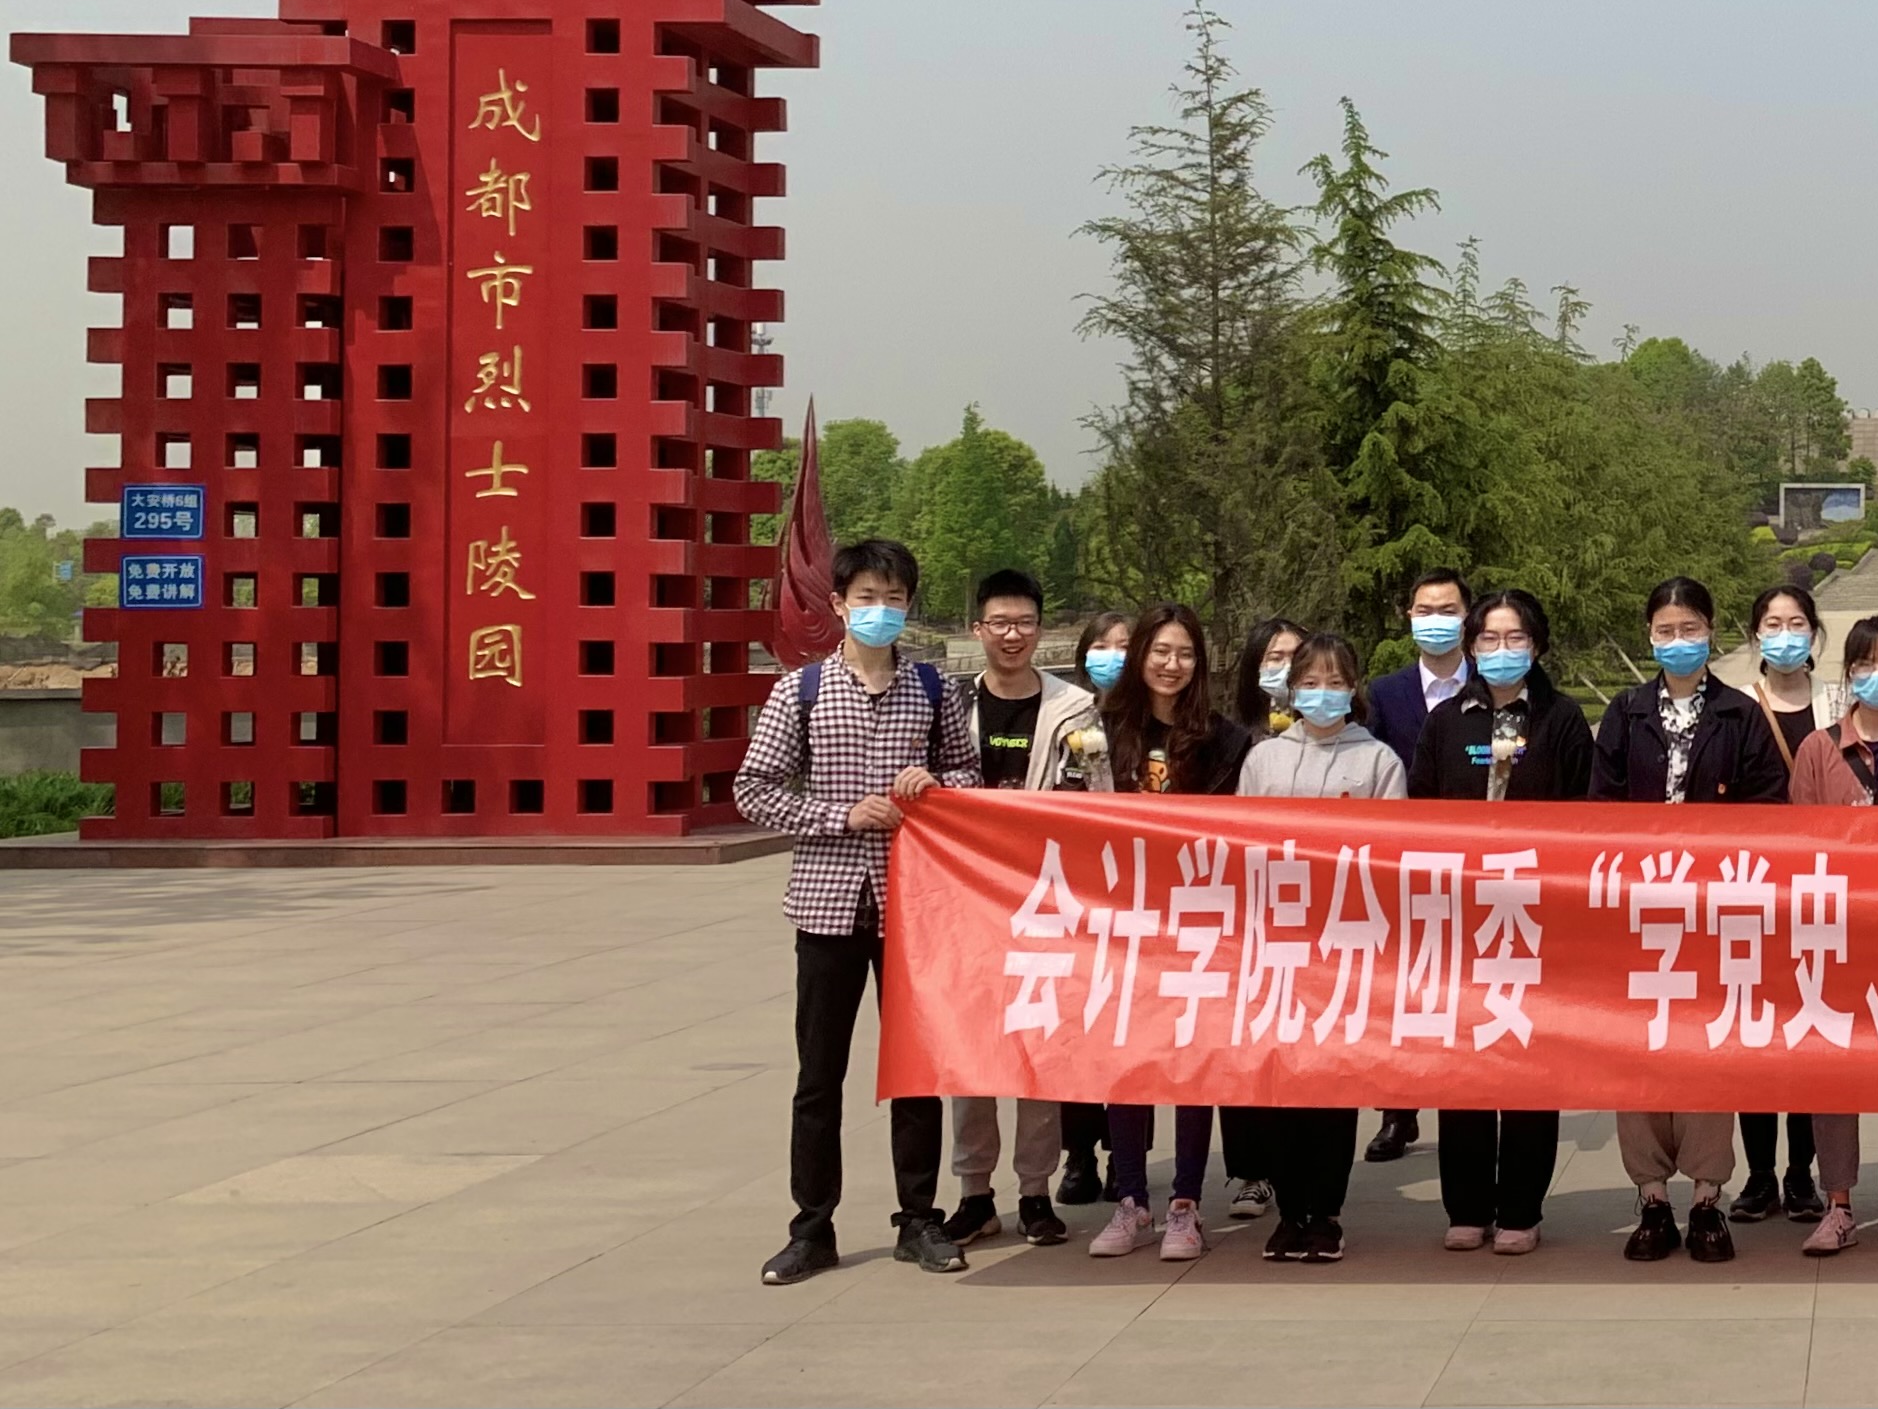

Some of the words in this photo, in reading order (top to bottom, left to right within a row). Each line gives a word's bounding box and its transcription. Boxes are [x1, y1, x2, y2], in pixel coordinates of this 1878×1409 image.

[464, 68, 541, 687] 成都市烈士陵园
[134, 511, 194, 531] 295号
[128, 562, 195, 579] 免费开放
[128, 583, 195, 600] 免费讲解
